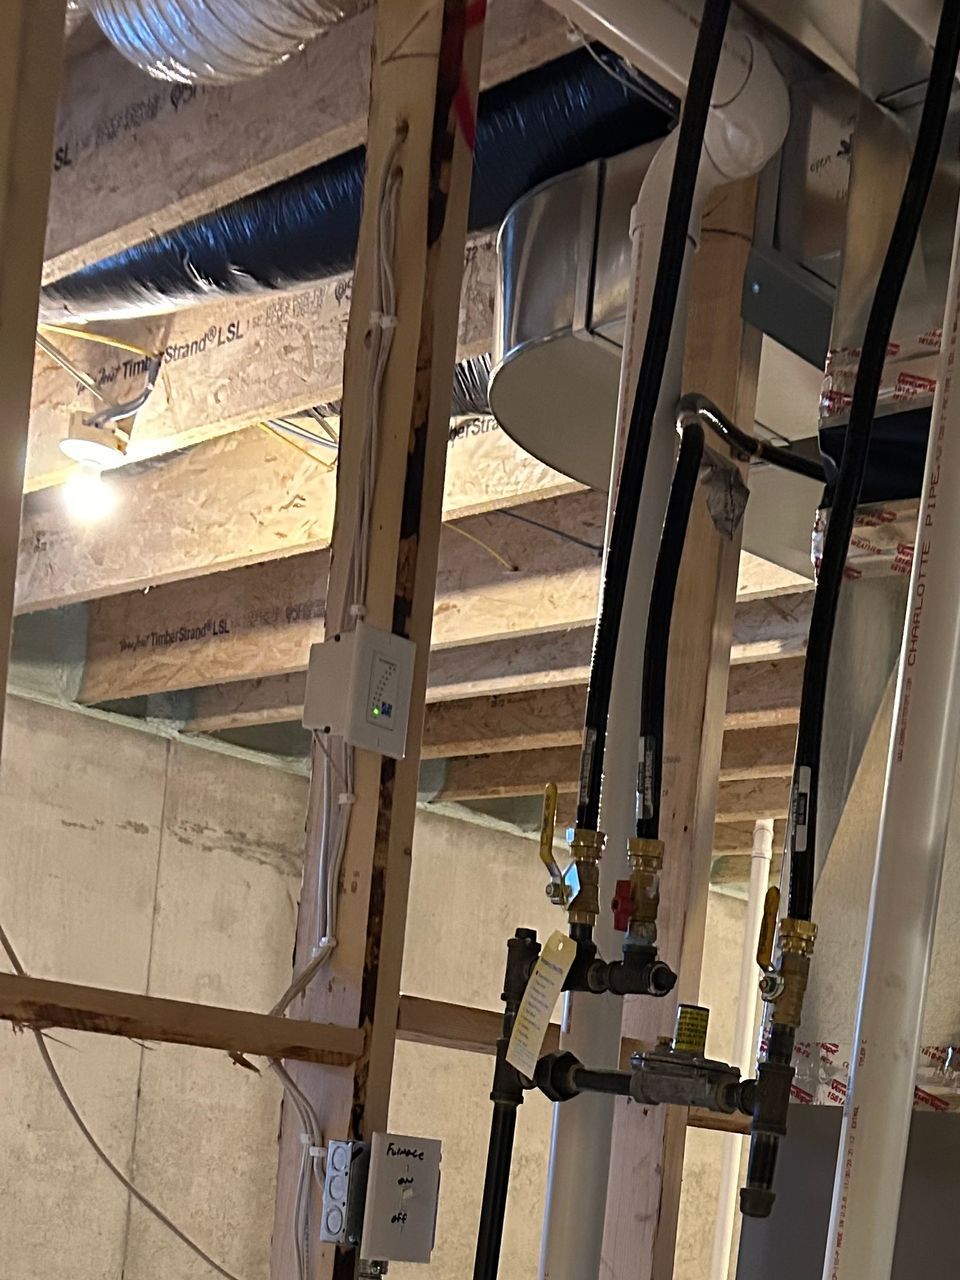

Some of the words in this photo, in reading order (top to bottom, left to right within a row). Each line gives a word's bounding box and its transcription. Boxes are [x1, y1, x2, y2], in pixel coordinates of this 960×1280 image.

[217, 320, 244, 344] LSL
[908, 540, 931, 666] CHARLOTTE
[212, 619, 230, 636] LSL
